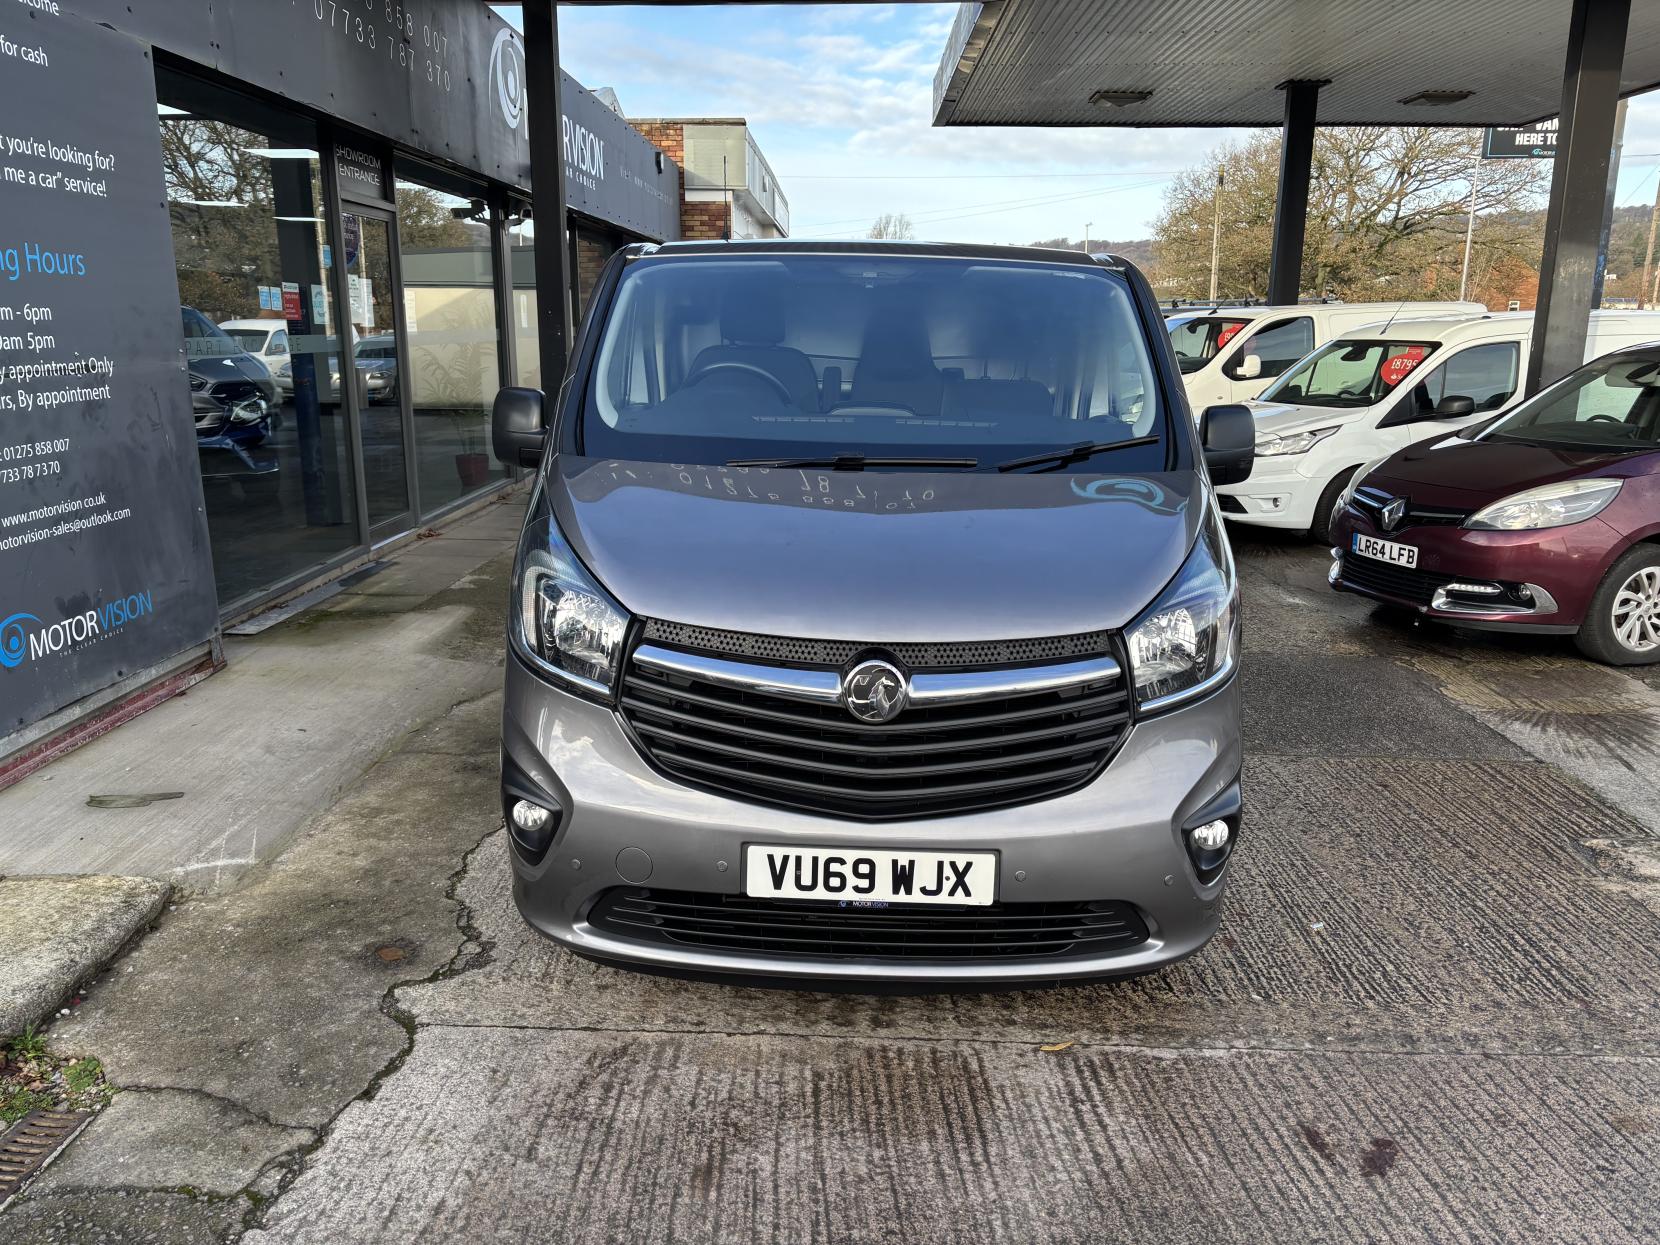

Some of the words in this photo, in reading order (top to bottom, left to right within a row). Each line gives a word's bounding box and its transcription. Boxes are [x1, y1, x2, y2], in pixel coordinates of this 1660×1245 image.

[0, 34, 18, 56] for
[21, 46, 48, 67] cash
[423, 25, 448, 58] 007
[387, 36, 415, 71] 787
[426, 60, 451, 91] 370
[1515, 132, 1545, 146] HERE
[6, 136, 46, 158] you're
[47, 140, 93, 172] looking
[94, 150, 115, 171] for?
[336, 145, 381, 169] SHOWROOM
[4, 166, 26, 183] me
[28, 170, 37, 186] a
[64, 177, 107, 198] service!
[339, 163, 381, 186] ENTRANCE
[24, 242, 86, 276] Hours
[23, 303, 53, 325] 6pm
[27, 332, 56, 354] 5pm
[8, 359, 87, 383] appointment
[88, 356, 114, 377] Only
[17, 389, 34, 411] By
[36, 384, 111, 410] appointment
[34, 440, 53, 456] 858
[53, 438, 70, 452] 007
[1358, 537, 1386, 559] LR64
[1389, 544, 1415, 565] LFB
[766, 853, 876, 894] VU69
[891, 858, 974, 898] WJX
